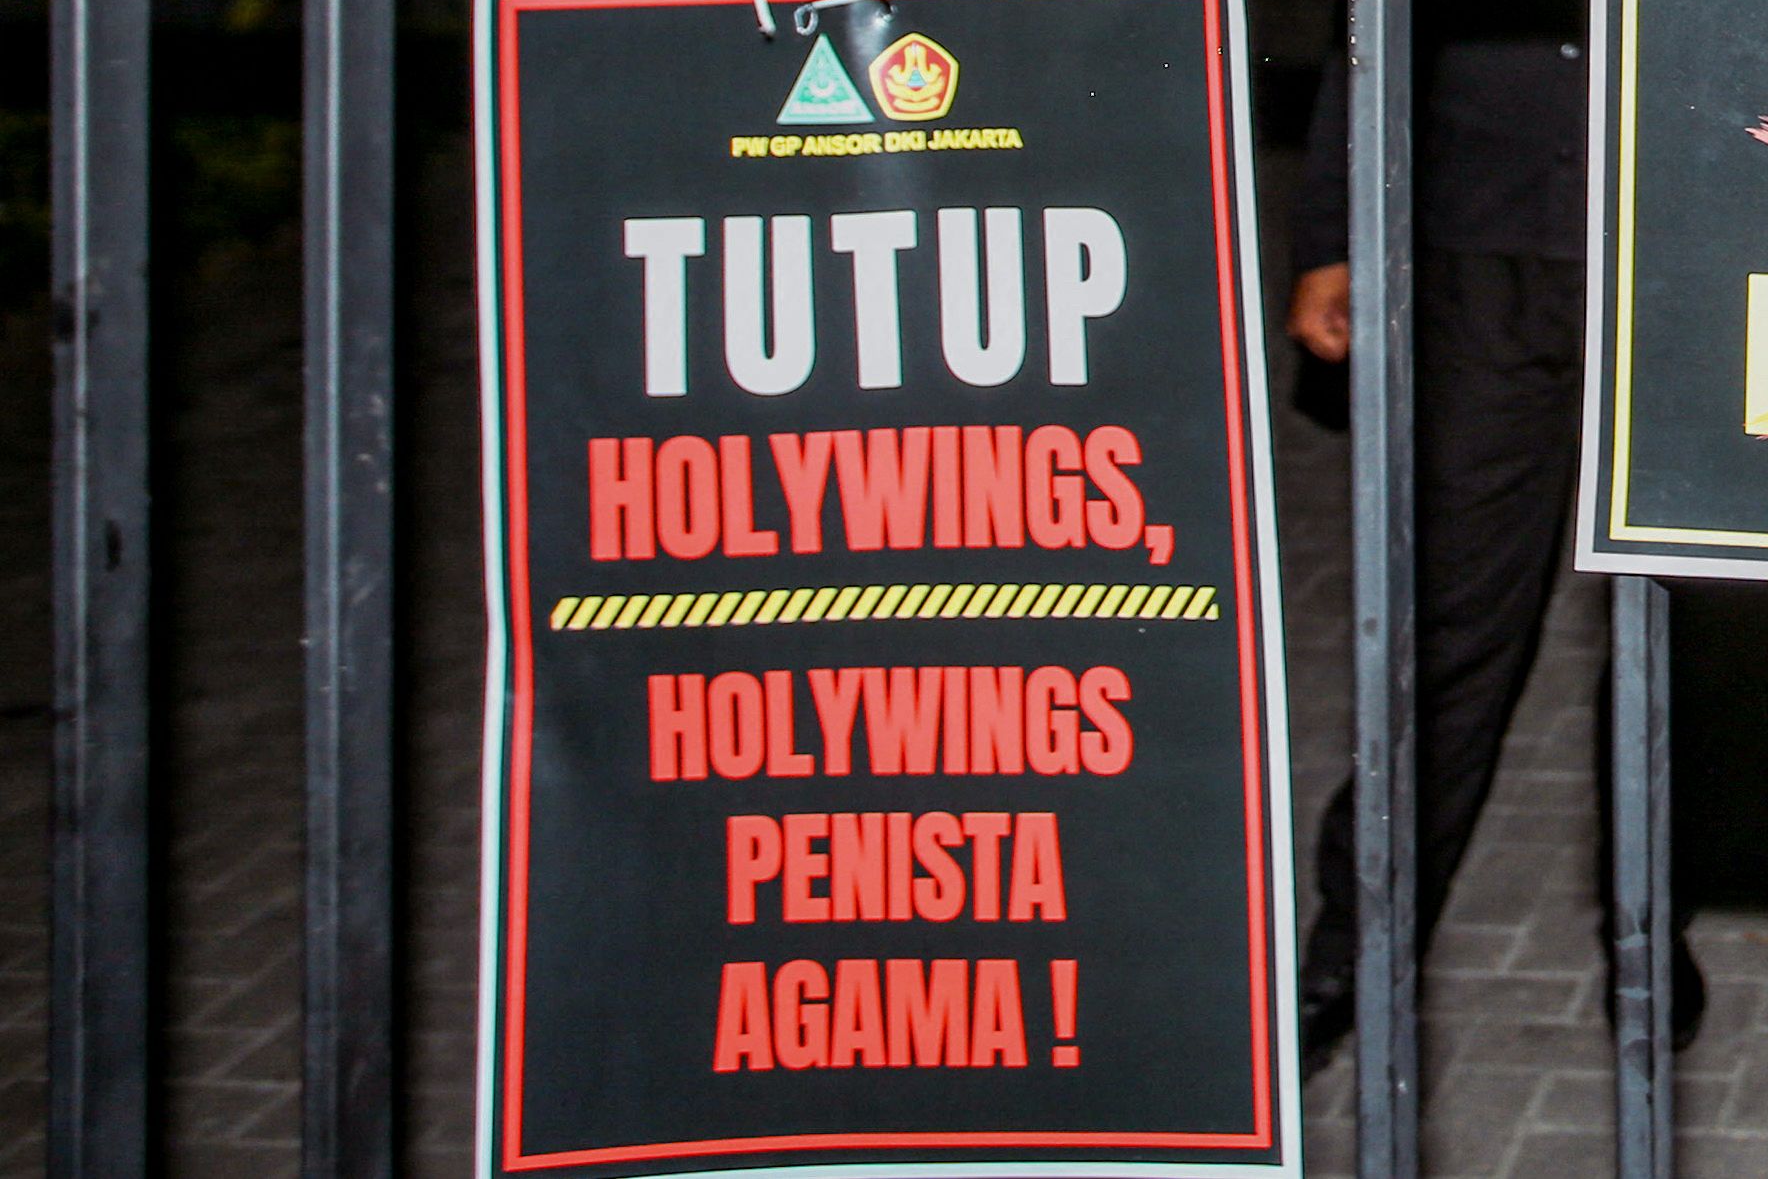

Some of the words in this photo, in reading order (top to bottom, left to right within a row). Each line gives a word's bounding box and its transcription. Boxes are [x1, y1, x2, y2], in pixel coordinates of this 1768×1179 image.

[730, 136, 768, 158] PW
[769, 136, 801, 157] GP
[801, 132, 883, 155] ANSOR
[884, 130, 927, 152] DKI
[927, 127, 1024, 151] JAKARTA
[623, 206, 1128, 397] TUTUP
[588, 424, 1175, 566] HOLYWINGS,
[647, 665, 1134, 781] HOLYWINGS
[725, 811, 1068, 924] PENISTA
[712, 958, 1029, 1072] AGAMA
